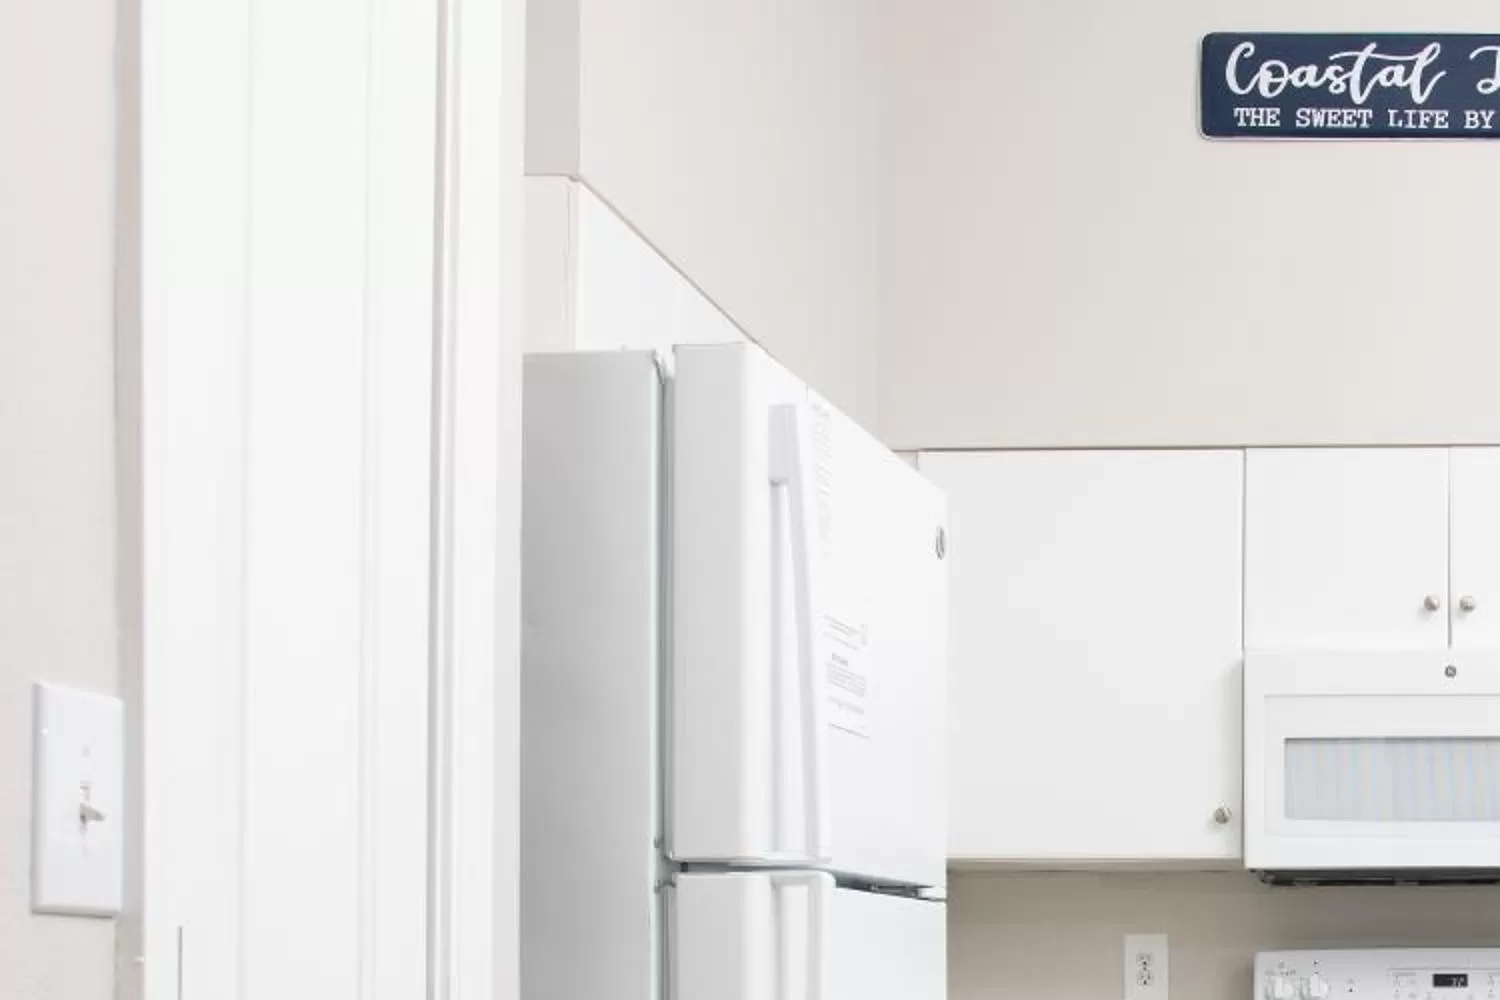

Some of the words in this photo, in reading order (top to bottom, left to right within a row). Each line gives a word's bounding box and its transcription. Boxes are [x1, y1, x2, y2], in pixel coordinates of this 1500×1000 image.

[1225, 41, 1446, 104] Coastal
[1233, 107, 1281, 127] THE
[1295, 107, 1373, 128] SWEET
[1387, 108, 1449, 128] LIFE
[1463, 108, 1496, 129] BY
